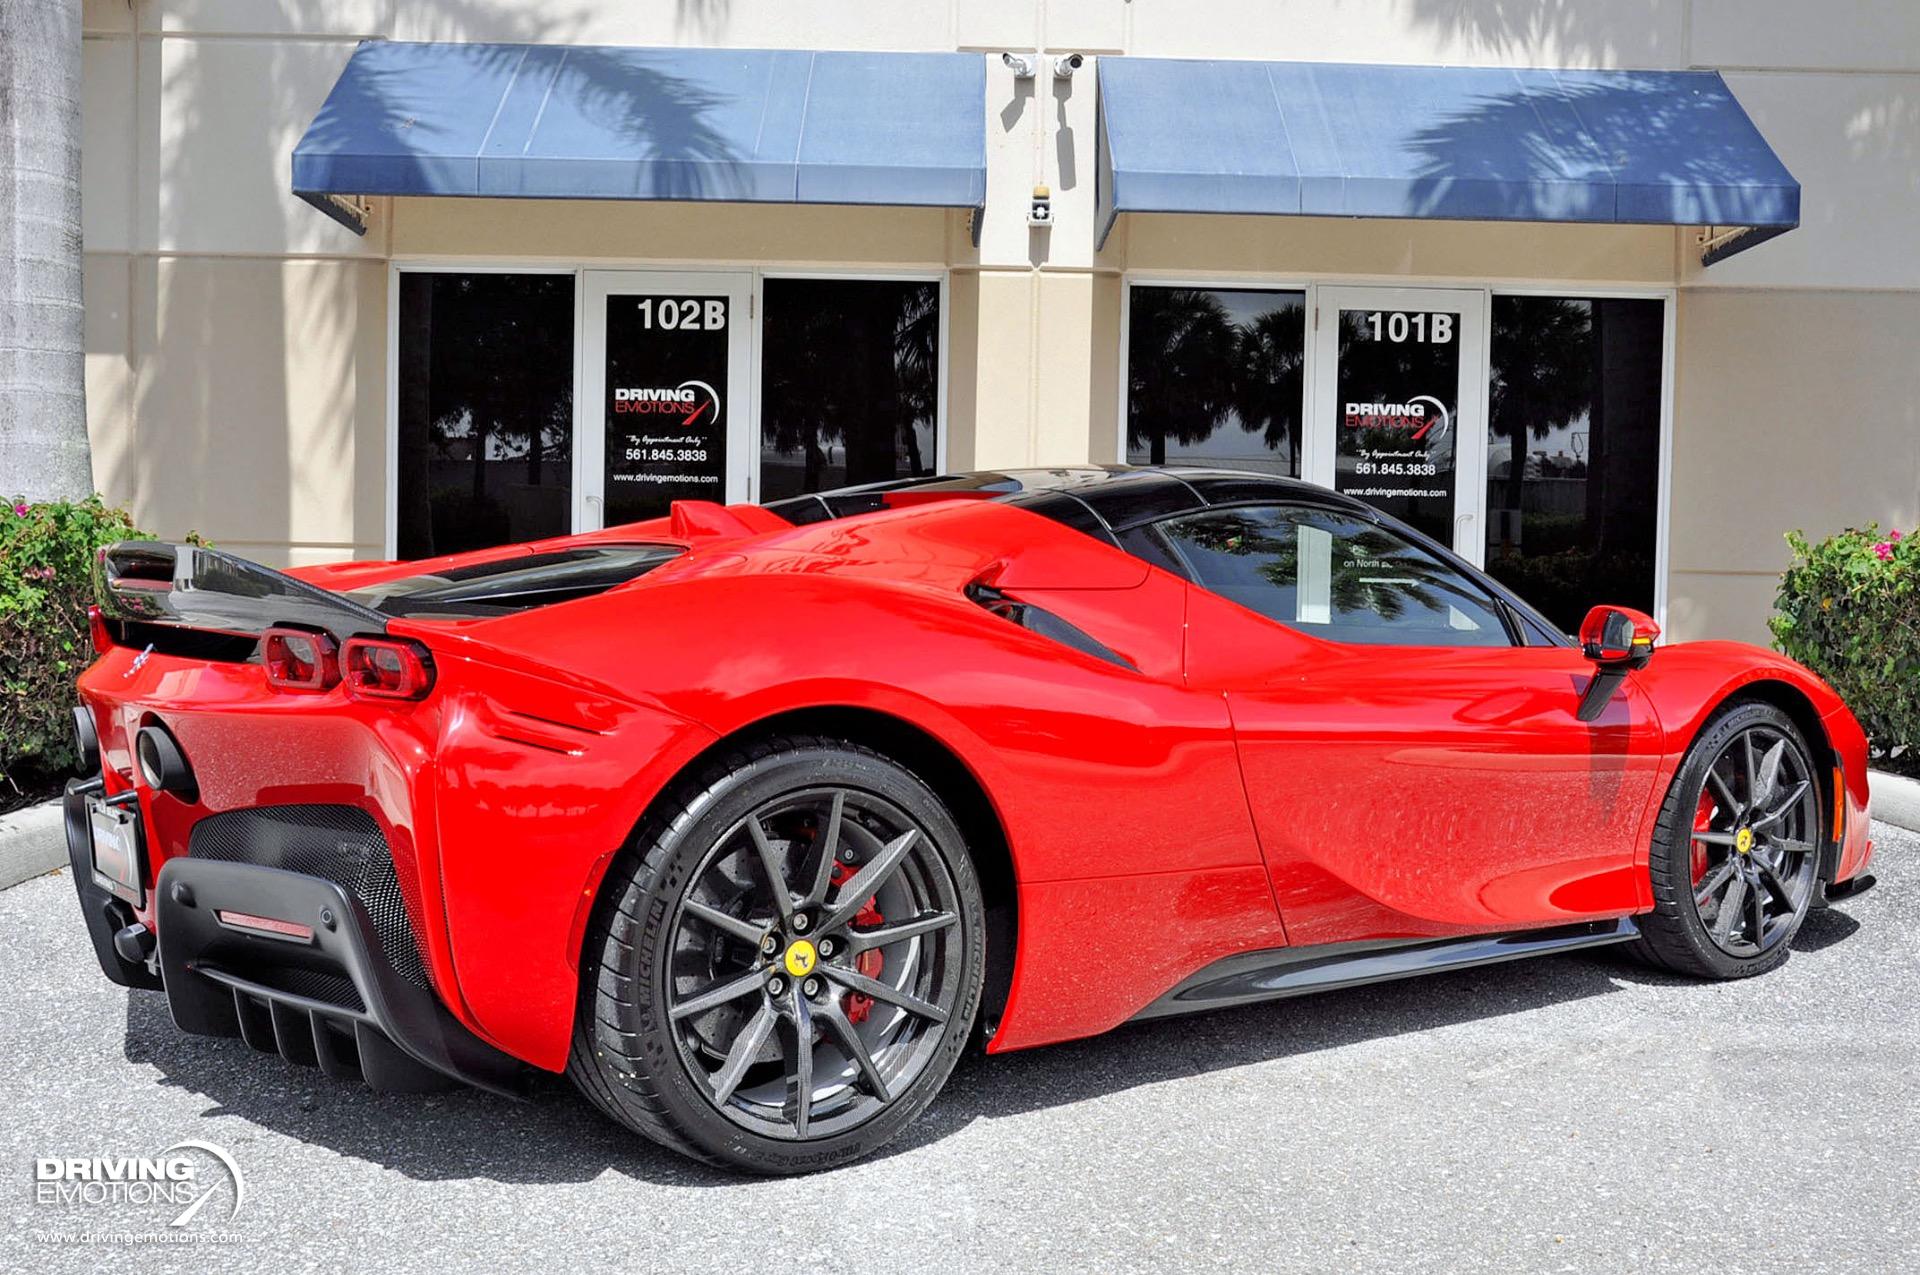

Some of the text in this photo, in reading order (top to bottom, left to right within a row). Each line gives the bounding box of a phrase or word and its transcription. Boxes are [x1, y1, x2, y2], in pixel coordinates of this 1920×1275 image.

[638, 298, 726, 331] 102B
[1368, 312, 1453, 344] 101B
[615, 388, 695, 402] DRIVING
[615, 401, 695, 414] EMOTIONS
[1345, 402, 1425, 417] DRIVING
[1345, 415, 1425, 429] EMOTIONS
[625, 448, 707, 462] 561.845.3838
[1355, 462, 1436, 476] 561.845.3838
[613, 472, 718, 484] www.drivingemotions.com
[1343, 487, 1447, 499] www.drivingemotions.com
[1343, 560, 1355, 568] on
[1356, 559, 1380, 568] North
